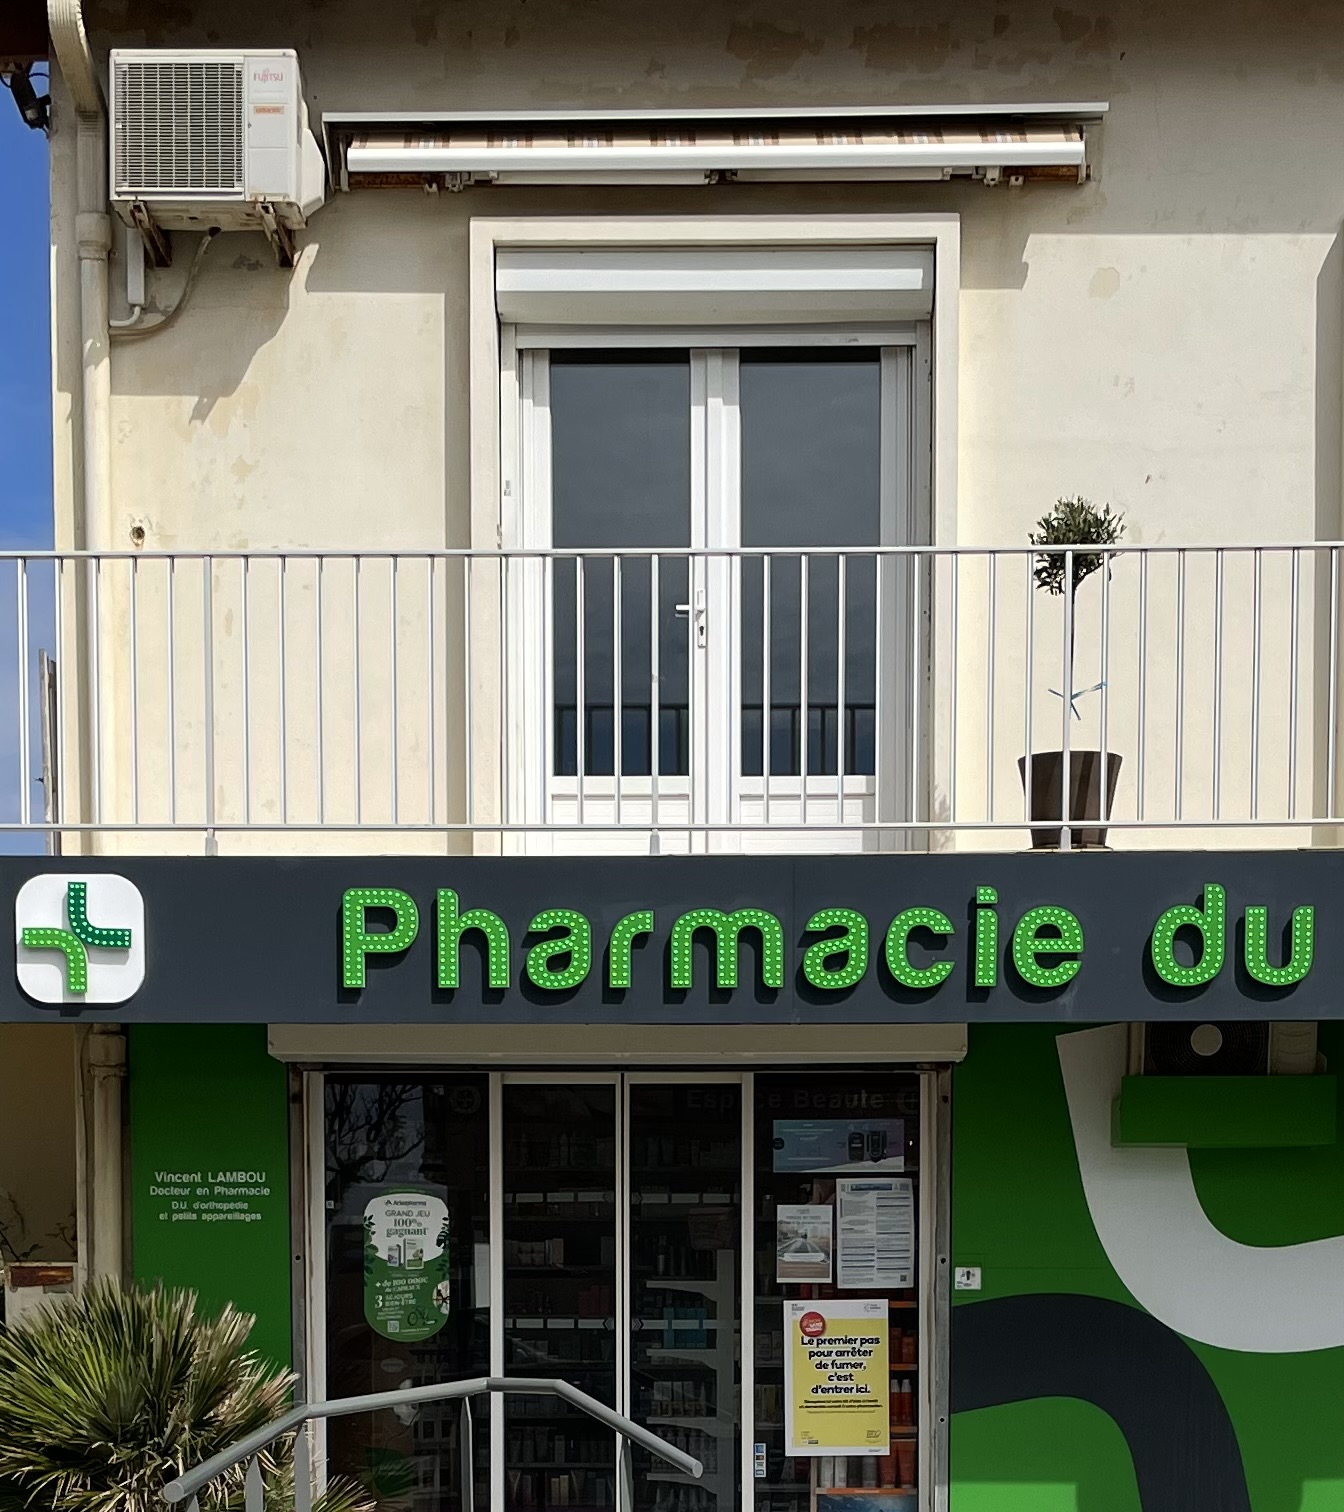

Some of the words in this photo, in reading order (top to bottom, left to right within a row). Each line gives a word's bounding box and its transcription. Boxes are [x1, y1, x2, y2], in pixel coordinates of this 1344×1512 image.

[343, 885, 1084, 990] Pharmacie
[1152, 883, 1315, 987] du
[155, 1171, 202, 1183] Vincent
[208, 1171, 266, 1183] LAMBOU
[150, 1185, 191, 1196] Docteur
[196, 1187, 210, 1196] en
[214, 1185, 271, 1196] Pharmacie
[385, 1210, 413, 1218] GRAND
[416, 1210, 430, 1218] JEU
[800, 1336, 815, 1345] Le
[816, 1335, 858, 1347] premier
[860, 1337, 880, 1347] pas
[808, 1350, 833, 1360] pour
[835, 1347, 873, 1357] arrêter
[815, 1361, 829, 1370] de
[831, 1360, 867, 1371] fumer,
[828, 1372, 854, 1382] c'est
[811, 1385, 855, 1395] d'entrer
[856, 1384, 871, 1394] ici.
